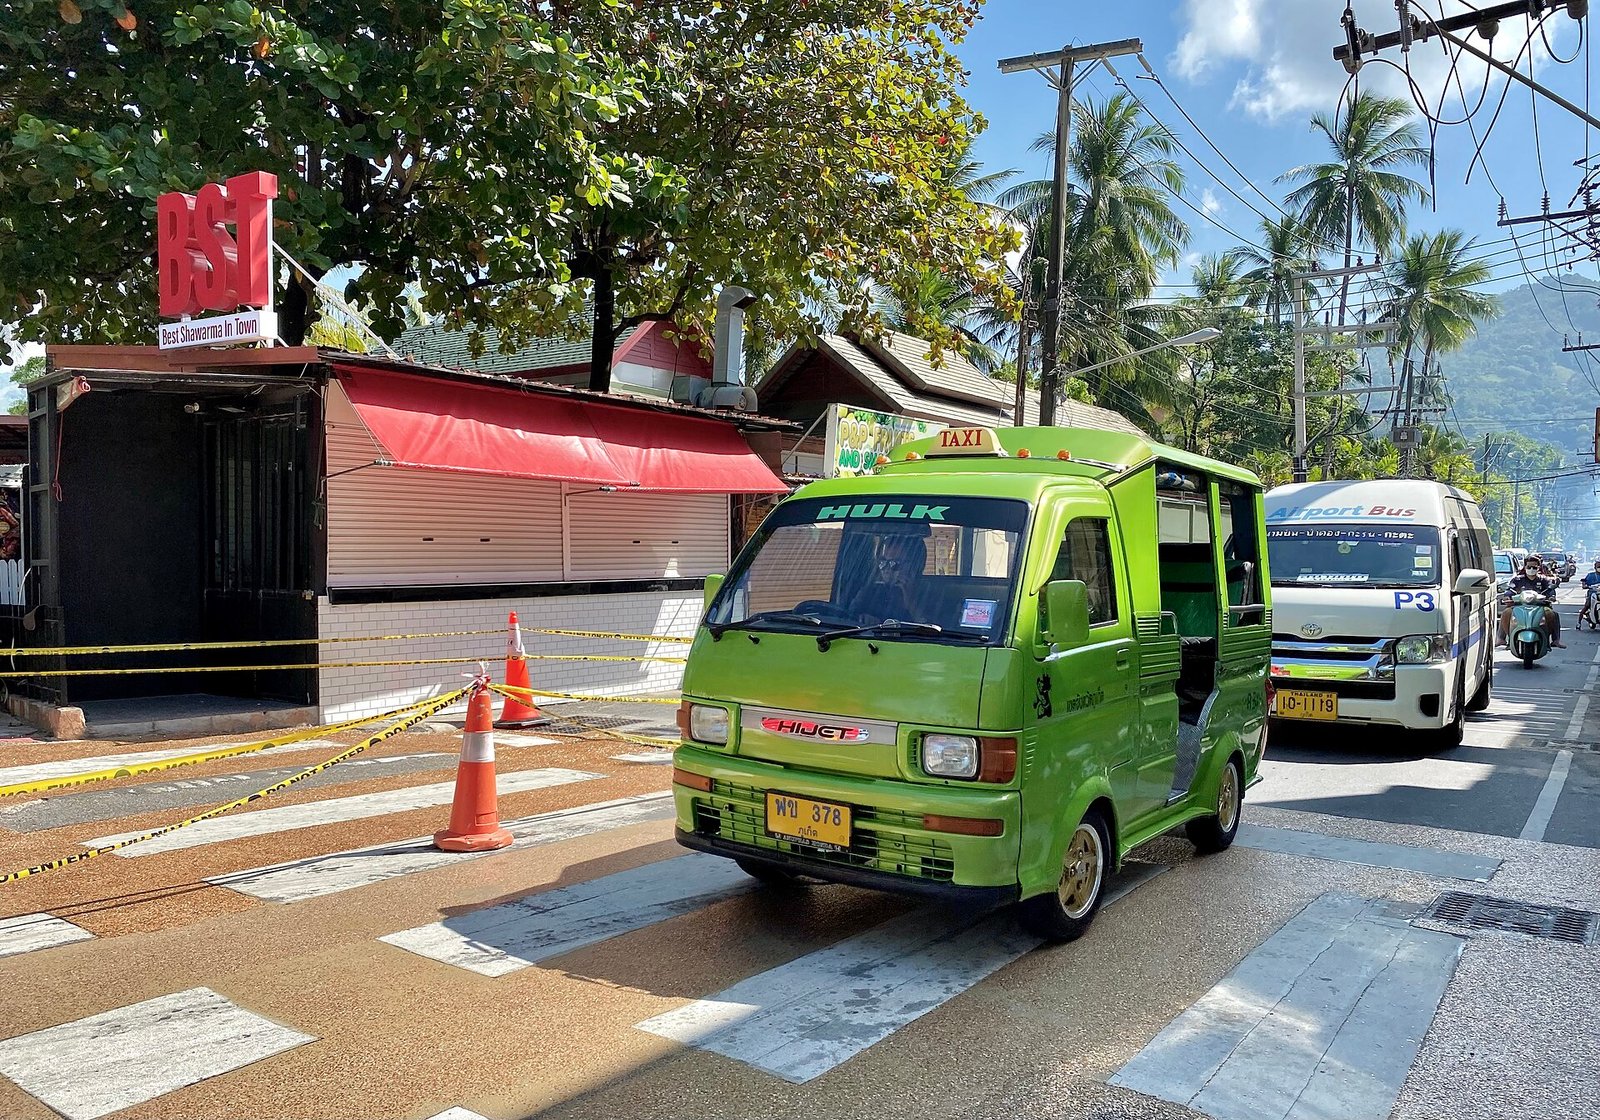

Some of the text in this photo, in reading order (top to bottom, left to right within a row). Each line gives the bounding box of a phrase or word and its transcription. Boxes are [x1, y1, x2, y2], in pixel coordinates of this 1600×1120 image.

[157, 171, 278, 318] BST
[162, 318, 257, 345] Best Shawarma In Town
[940, 429, 982, 447] TAXI
[839, 449, 860, 469] AND
[816, 504, 950, 521] HULK
[1269, 505, 1417, 521] Airport Bus
[1394, 591, 1435, 612] P3
[1283, 696, 1334, 713] 10-1119
[777, 720, 854, 740] HIJET
[812, 804, 842, 826] 378
